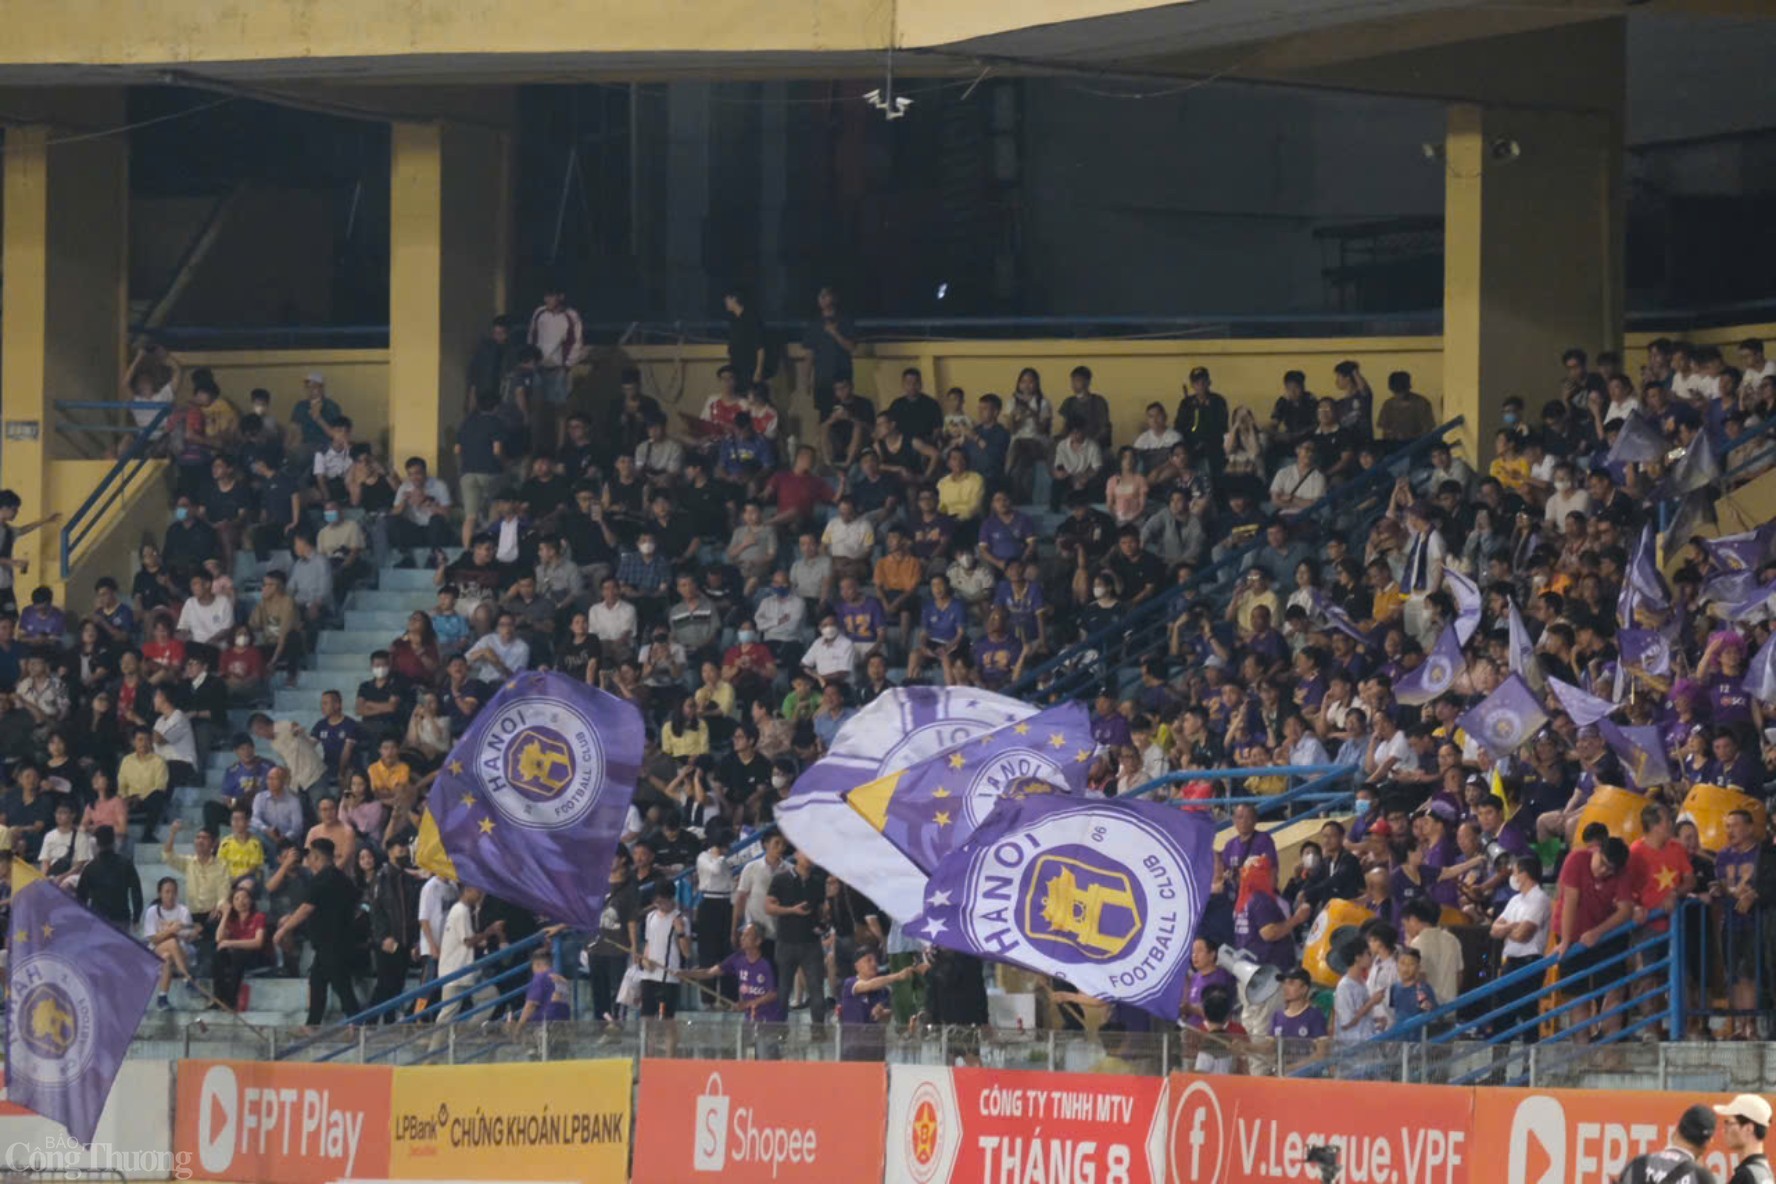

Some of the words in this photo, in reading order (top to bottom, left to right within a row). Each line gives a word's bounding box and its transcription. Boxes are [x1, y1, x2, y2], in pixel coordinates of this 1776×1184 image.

[483, 709, 527, 792] HANOI
[575, 731, 592, 762] CLUB
[555, 768, 592, 817] FOOTBALL
[979, 832, 1042, 955] HANOI
[1142, 854, 1176, 900] CLUB
[1109, 911, 1178, 989] FOOTBALL
[240, 1087, 299, 1155] FPT
[300, 1089, 365, 1178] Play
[396, 1114, 438, 1141] LPBank
[450, 1105, 504, 1148] CHỨNG
[506, 1103, 560, 1147] KHOÁN
[563, 1112, 623, 1145] LPBANK
[978, 1084, 1023, 1117] CÔNG
[1026, 1089, 1048, 1119] TY
[1051, 1091, 1094, 1121] TNHH
[1096, 1093, 1134, 1125] MTV
[731, 1106, 817, 1179] Shopee
[978, 1126, 1097, 1184] THÁNG
[1106, 1143, 1131, 1184] 8
